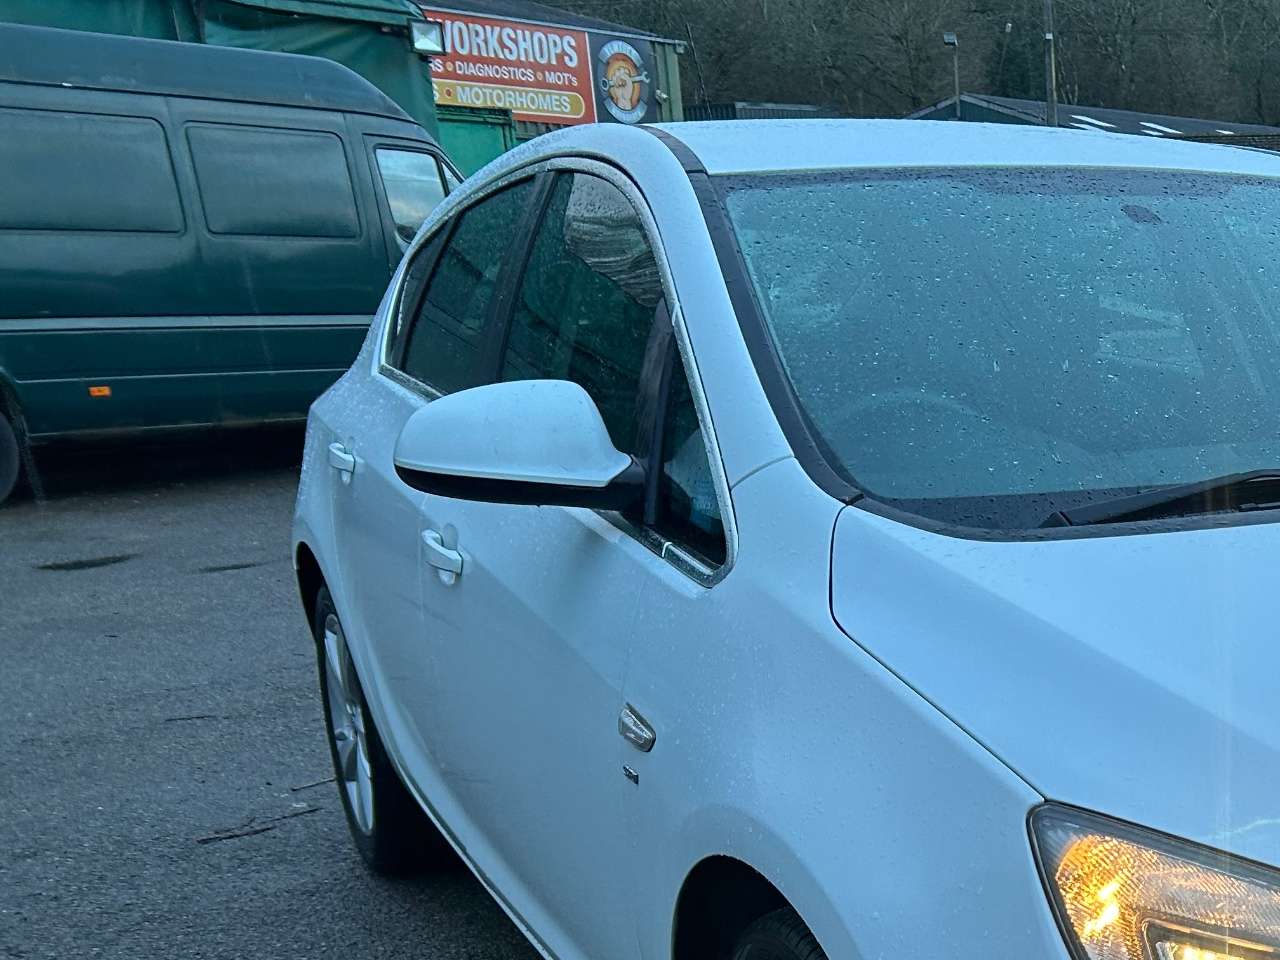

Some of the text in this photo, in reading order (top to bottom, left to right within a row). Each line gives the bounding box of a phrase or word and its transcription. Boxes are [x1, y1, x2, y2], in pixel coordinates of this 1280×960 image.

[455, 61, 535, 82] DIAGNOSTICS
[545, 71, 577, 87] MOT's
[456, 86, 571, 113] MOTORHOMES
